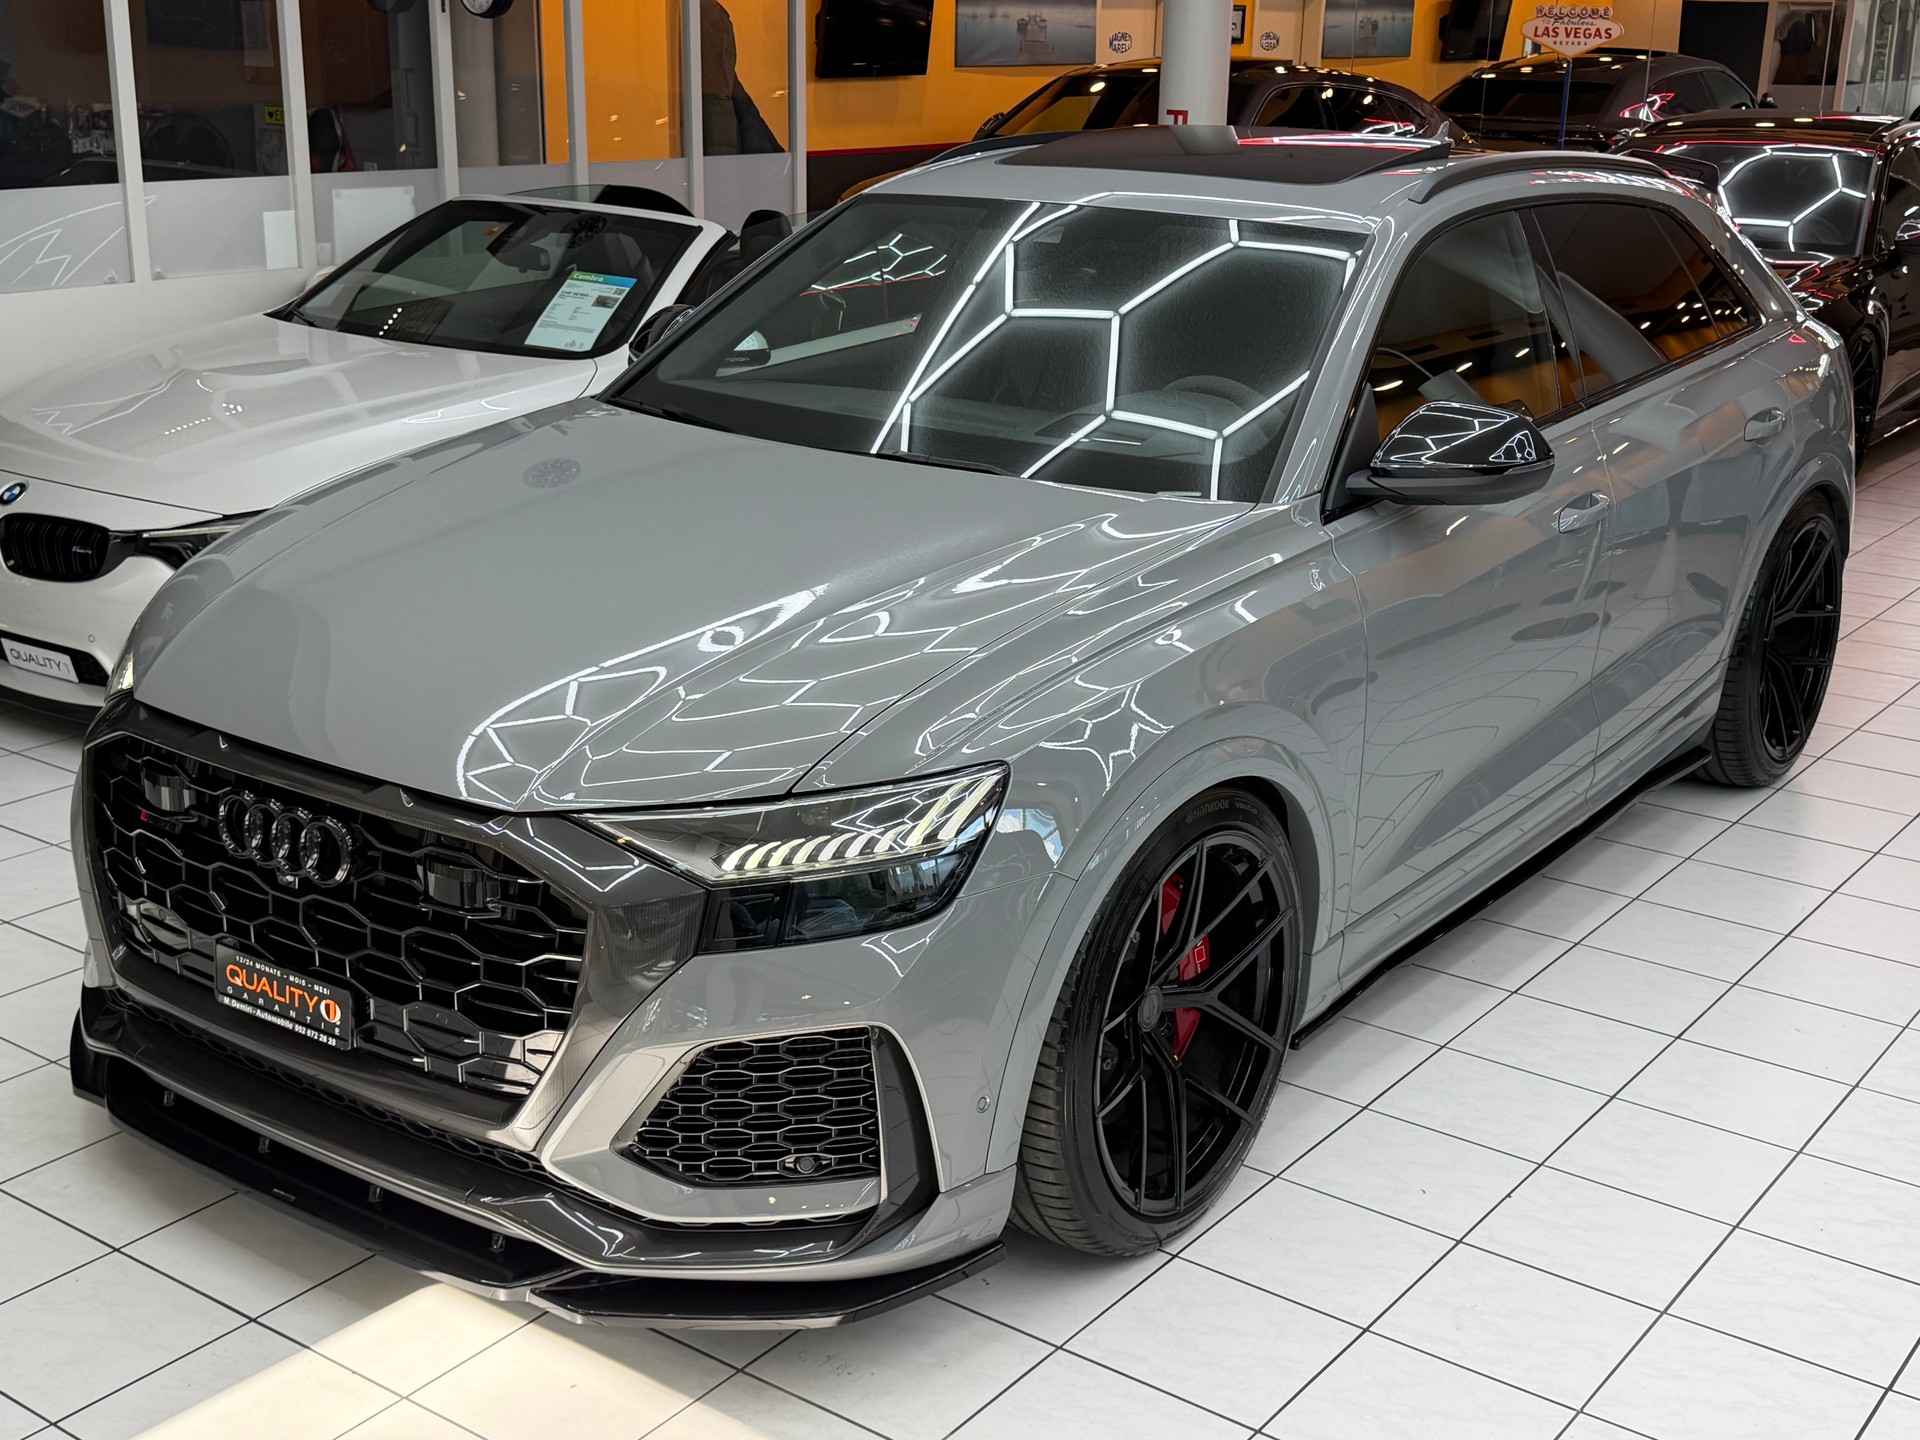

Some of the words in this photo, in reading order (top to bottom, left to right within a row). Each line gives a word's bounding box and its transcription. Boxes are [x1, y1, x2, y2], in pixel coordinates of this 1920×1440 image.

[1536, 6, 1611, 17] WELCOME
[1551, 17, 1596, 26] Fabulous
[1534, 26, 1559, 37] LAS
[1565, 28, 1612, 39] VEGAS
[573, 273, 604, 282] Cembra
[236, 956, 254, 967] 12/24
[255, 963, 281, 977] MONATE
[289, 974, 306, 987] MOIS
[314, 983, 331, 996] MESI
[226, 964, 319, 1013] QUALITY
[226, 985, 341, 1036] GARANTIE
